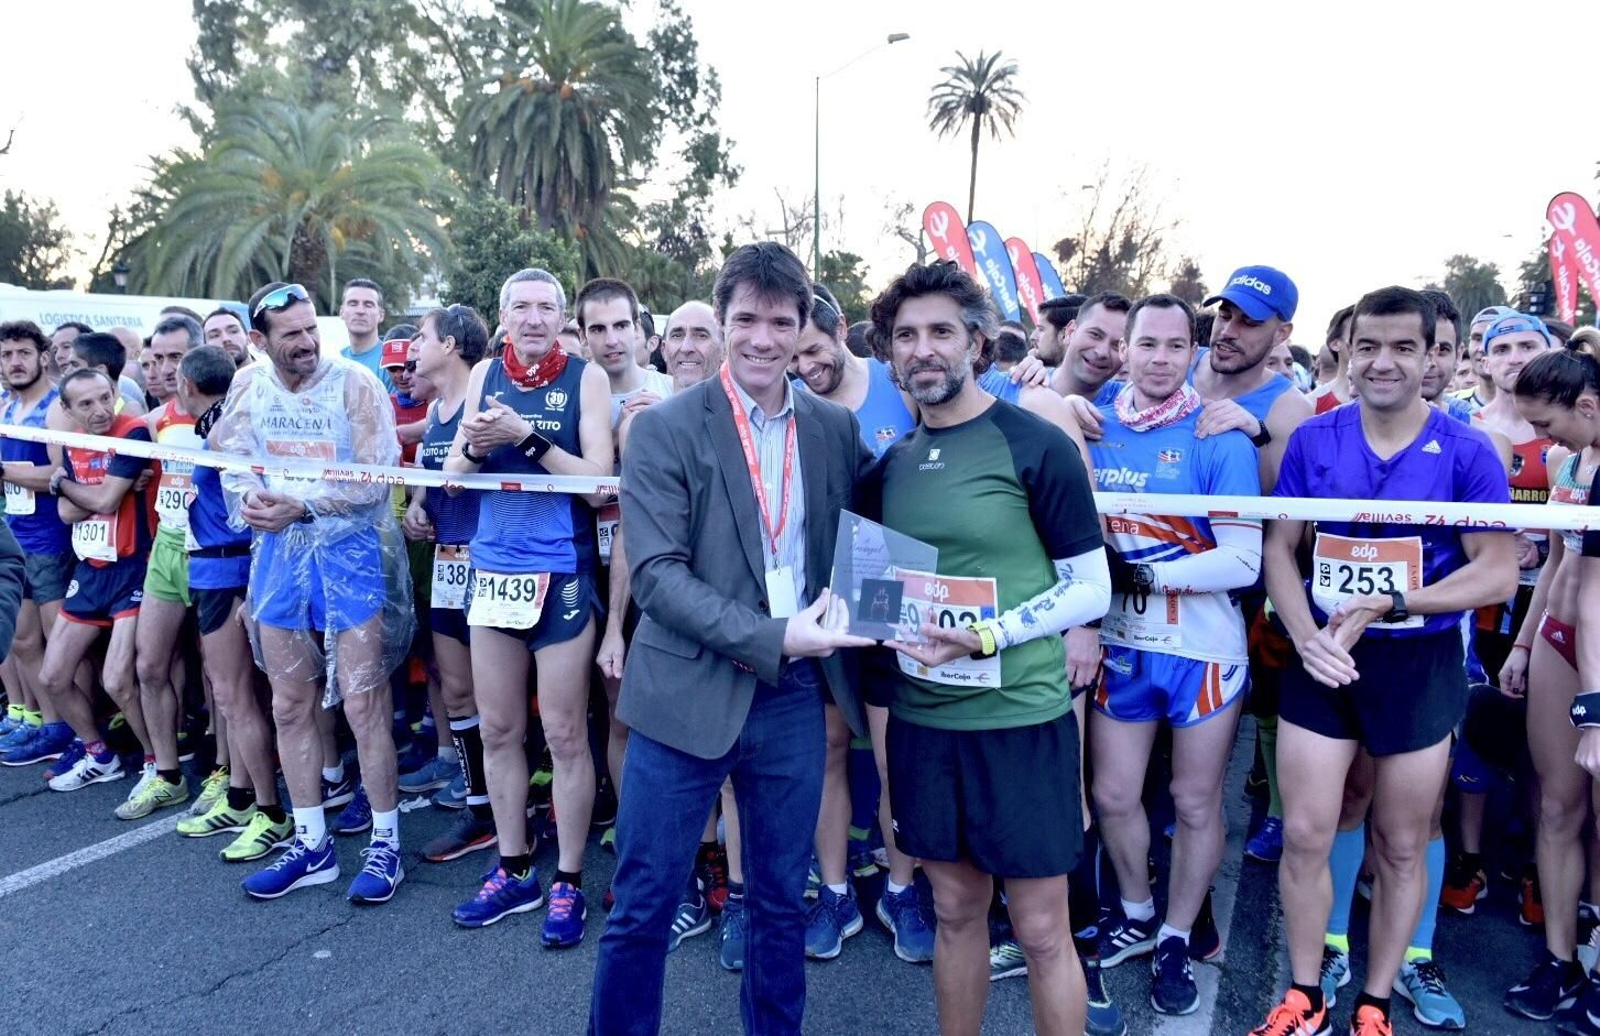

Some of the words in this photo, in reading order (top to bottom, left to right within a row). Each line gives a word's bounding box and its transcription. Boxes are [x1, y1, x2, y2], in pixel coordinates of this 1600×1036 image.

[39, 313, 93, 326] LOGISTICA
[93, 315, 144, 328] SANITARIA
[261, 416, 332, 430] MARACENA
[78, 523, 106, 541] 1301
[1350, 543, 1378, 561] edp
[1338, 564, 1395, 595] 253
[488, 577, 536, 602] 1439
[924, 582, 950, 603] edp
